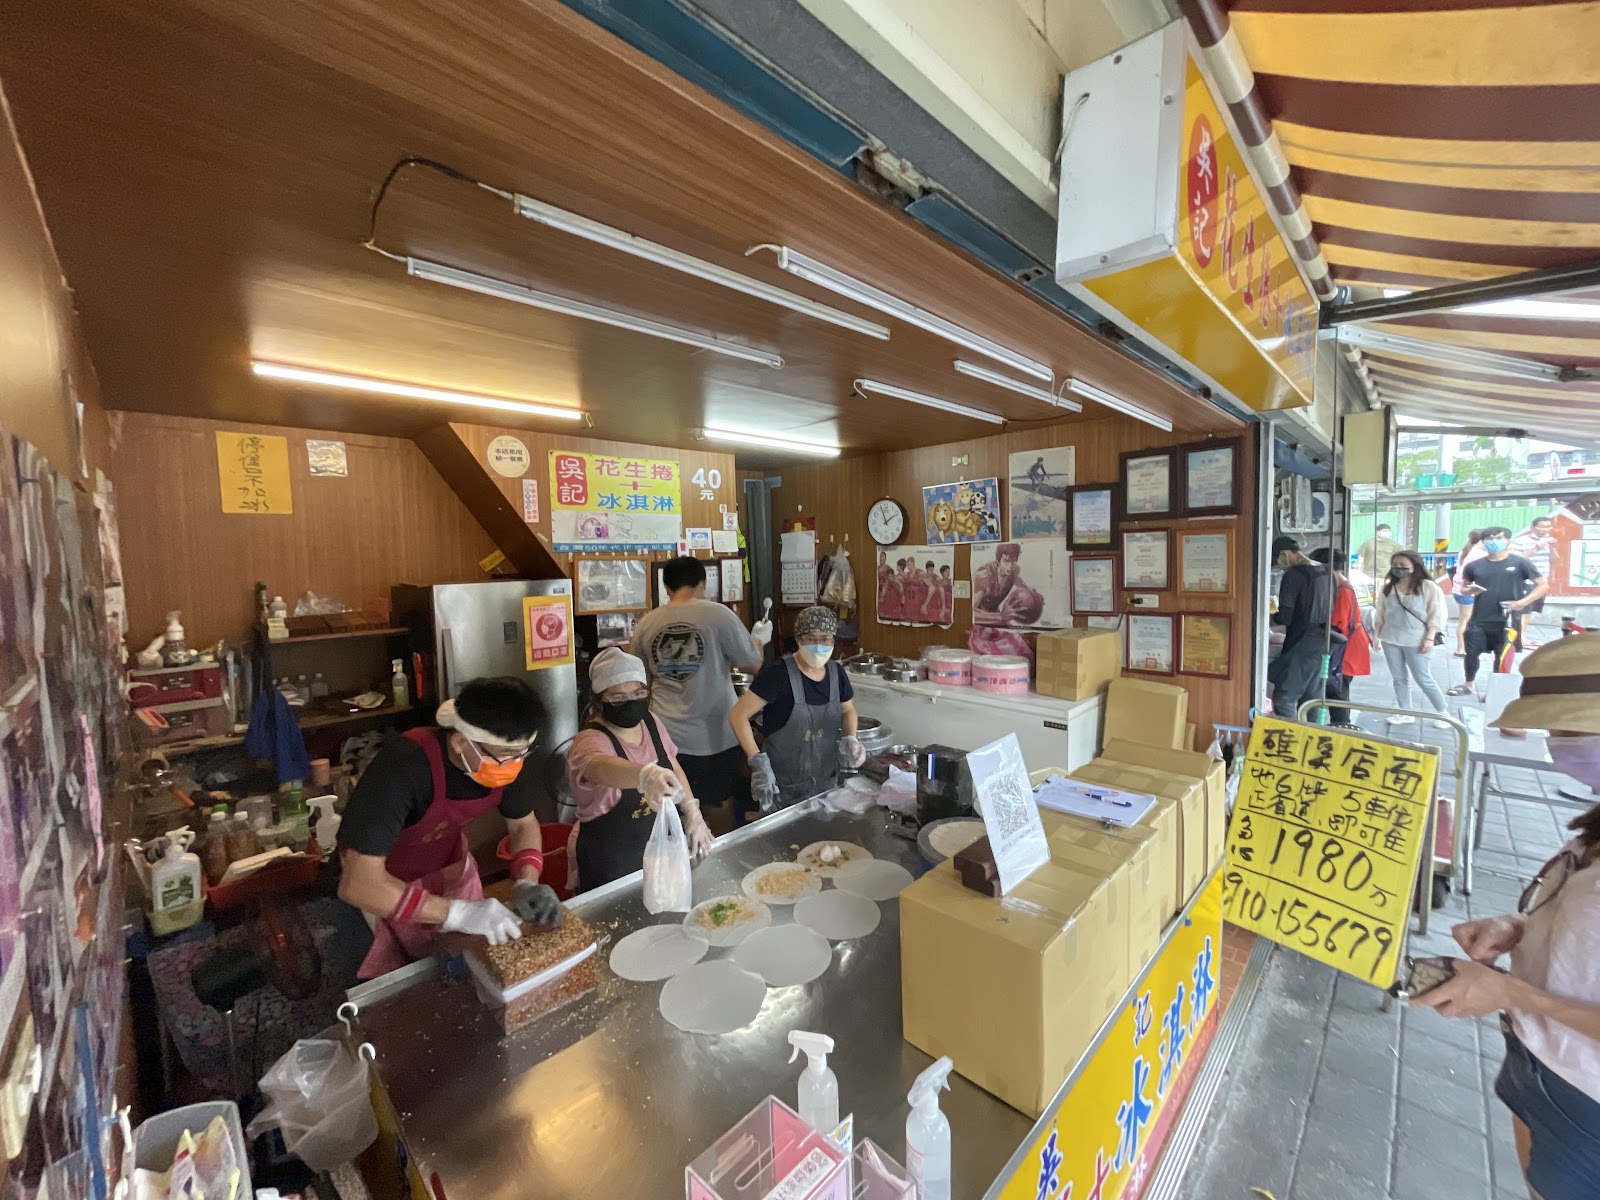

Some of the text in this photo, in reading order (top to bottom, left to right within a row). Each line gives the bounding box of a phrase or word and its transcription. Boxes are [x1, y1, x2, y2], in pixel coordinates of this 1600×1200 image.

[1193, 124, 1214, 260] 吳記
[558, 457, 586, 504] 吳記
[594, 458, 674, 481] 花生捲
[691, 467, 722, 489] 40
[596, 492, 675, 512] 冰淇淋
[700, 489, 714, 501] 元
